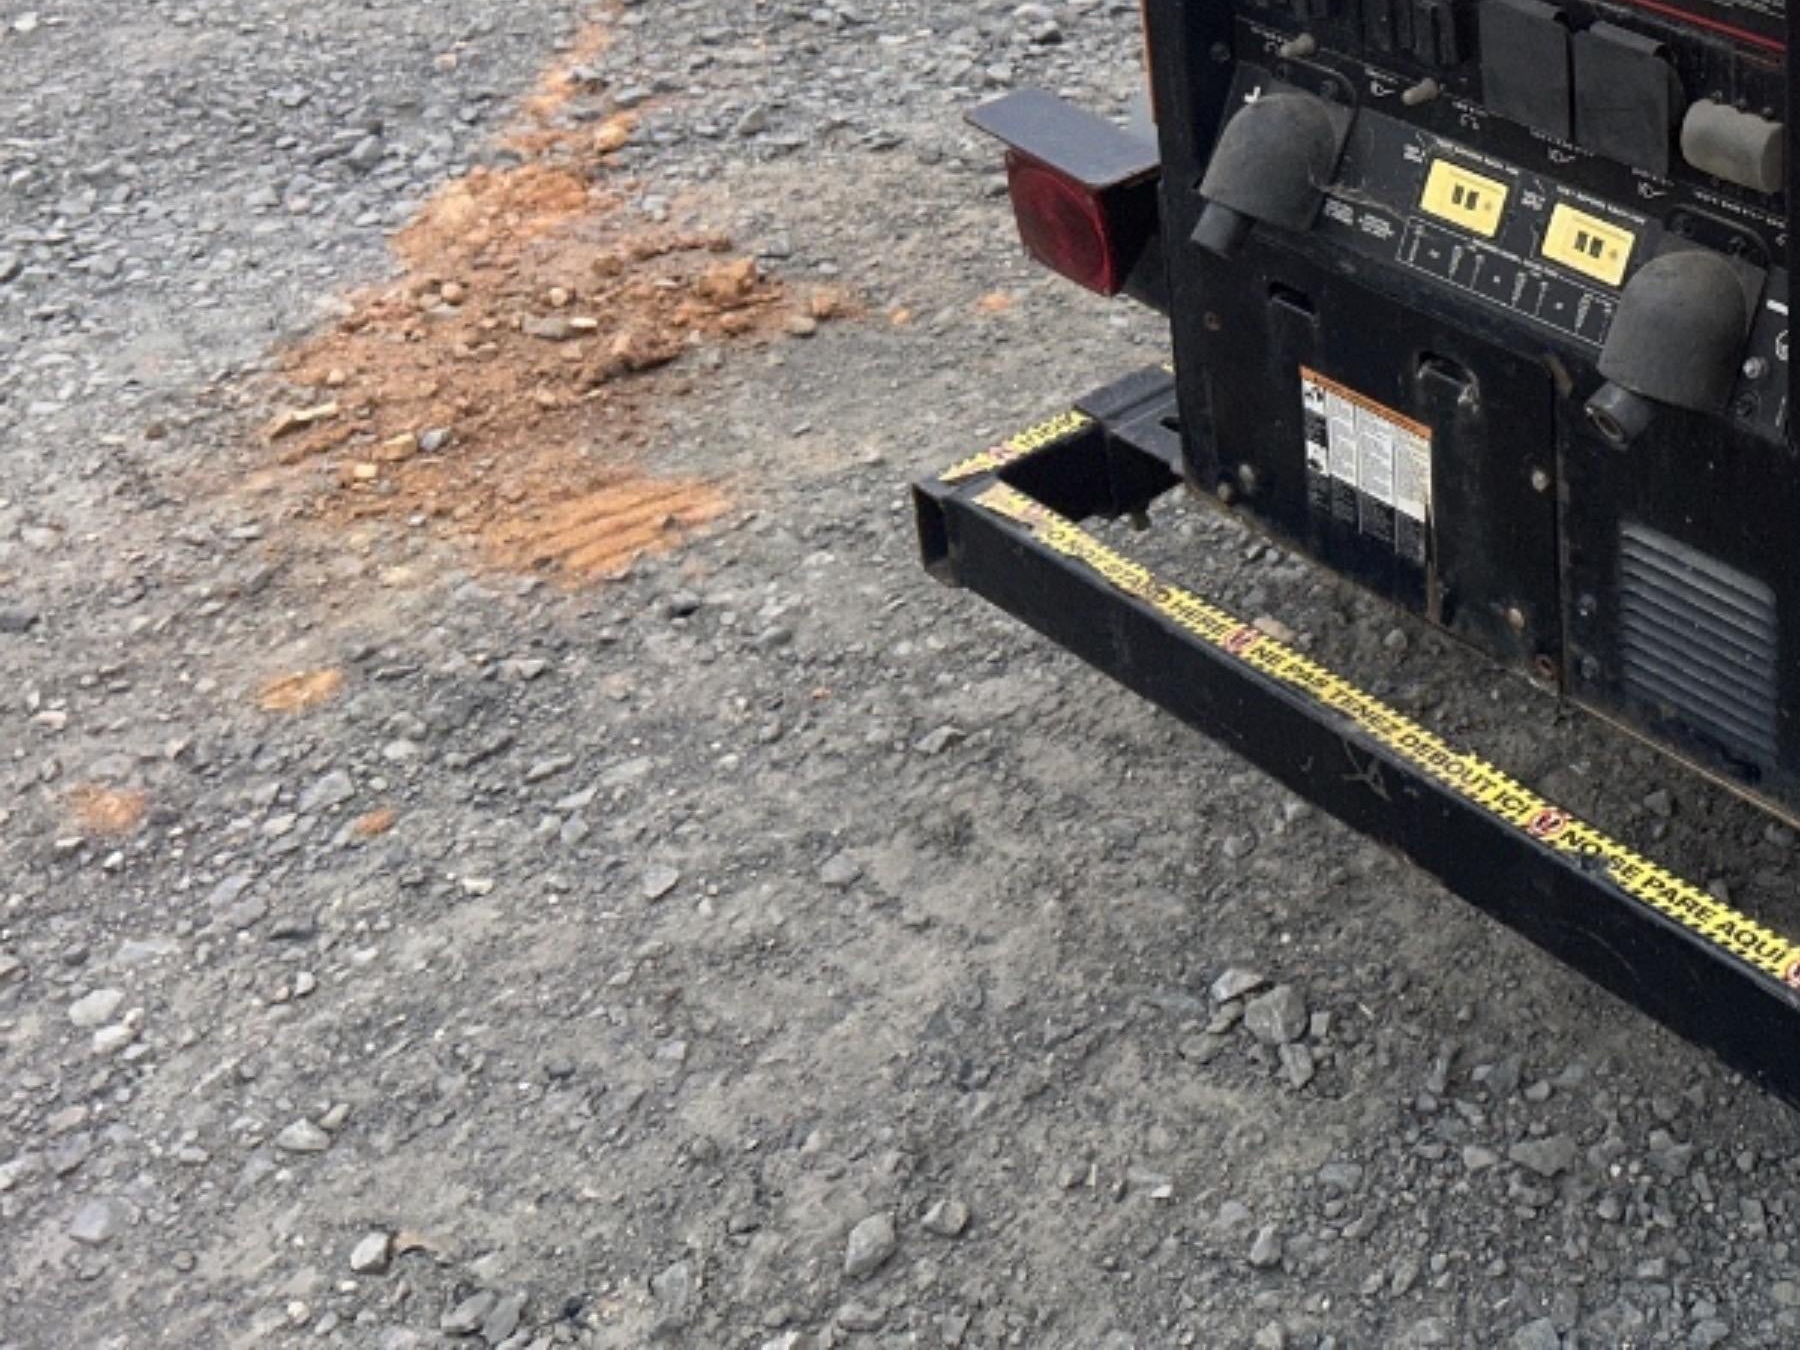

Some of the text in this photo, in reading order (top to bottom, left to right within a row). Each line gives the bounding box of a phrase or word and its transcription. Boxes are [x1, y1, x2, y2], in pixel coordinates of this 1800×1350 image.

[1559, 830, 1788, 965] NO SE PARE AQUI
